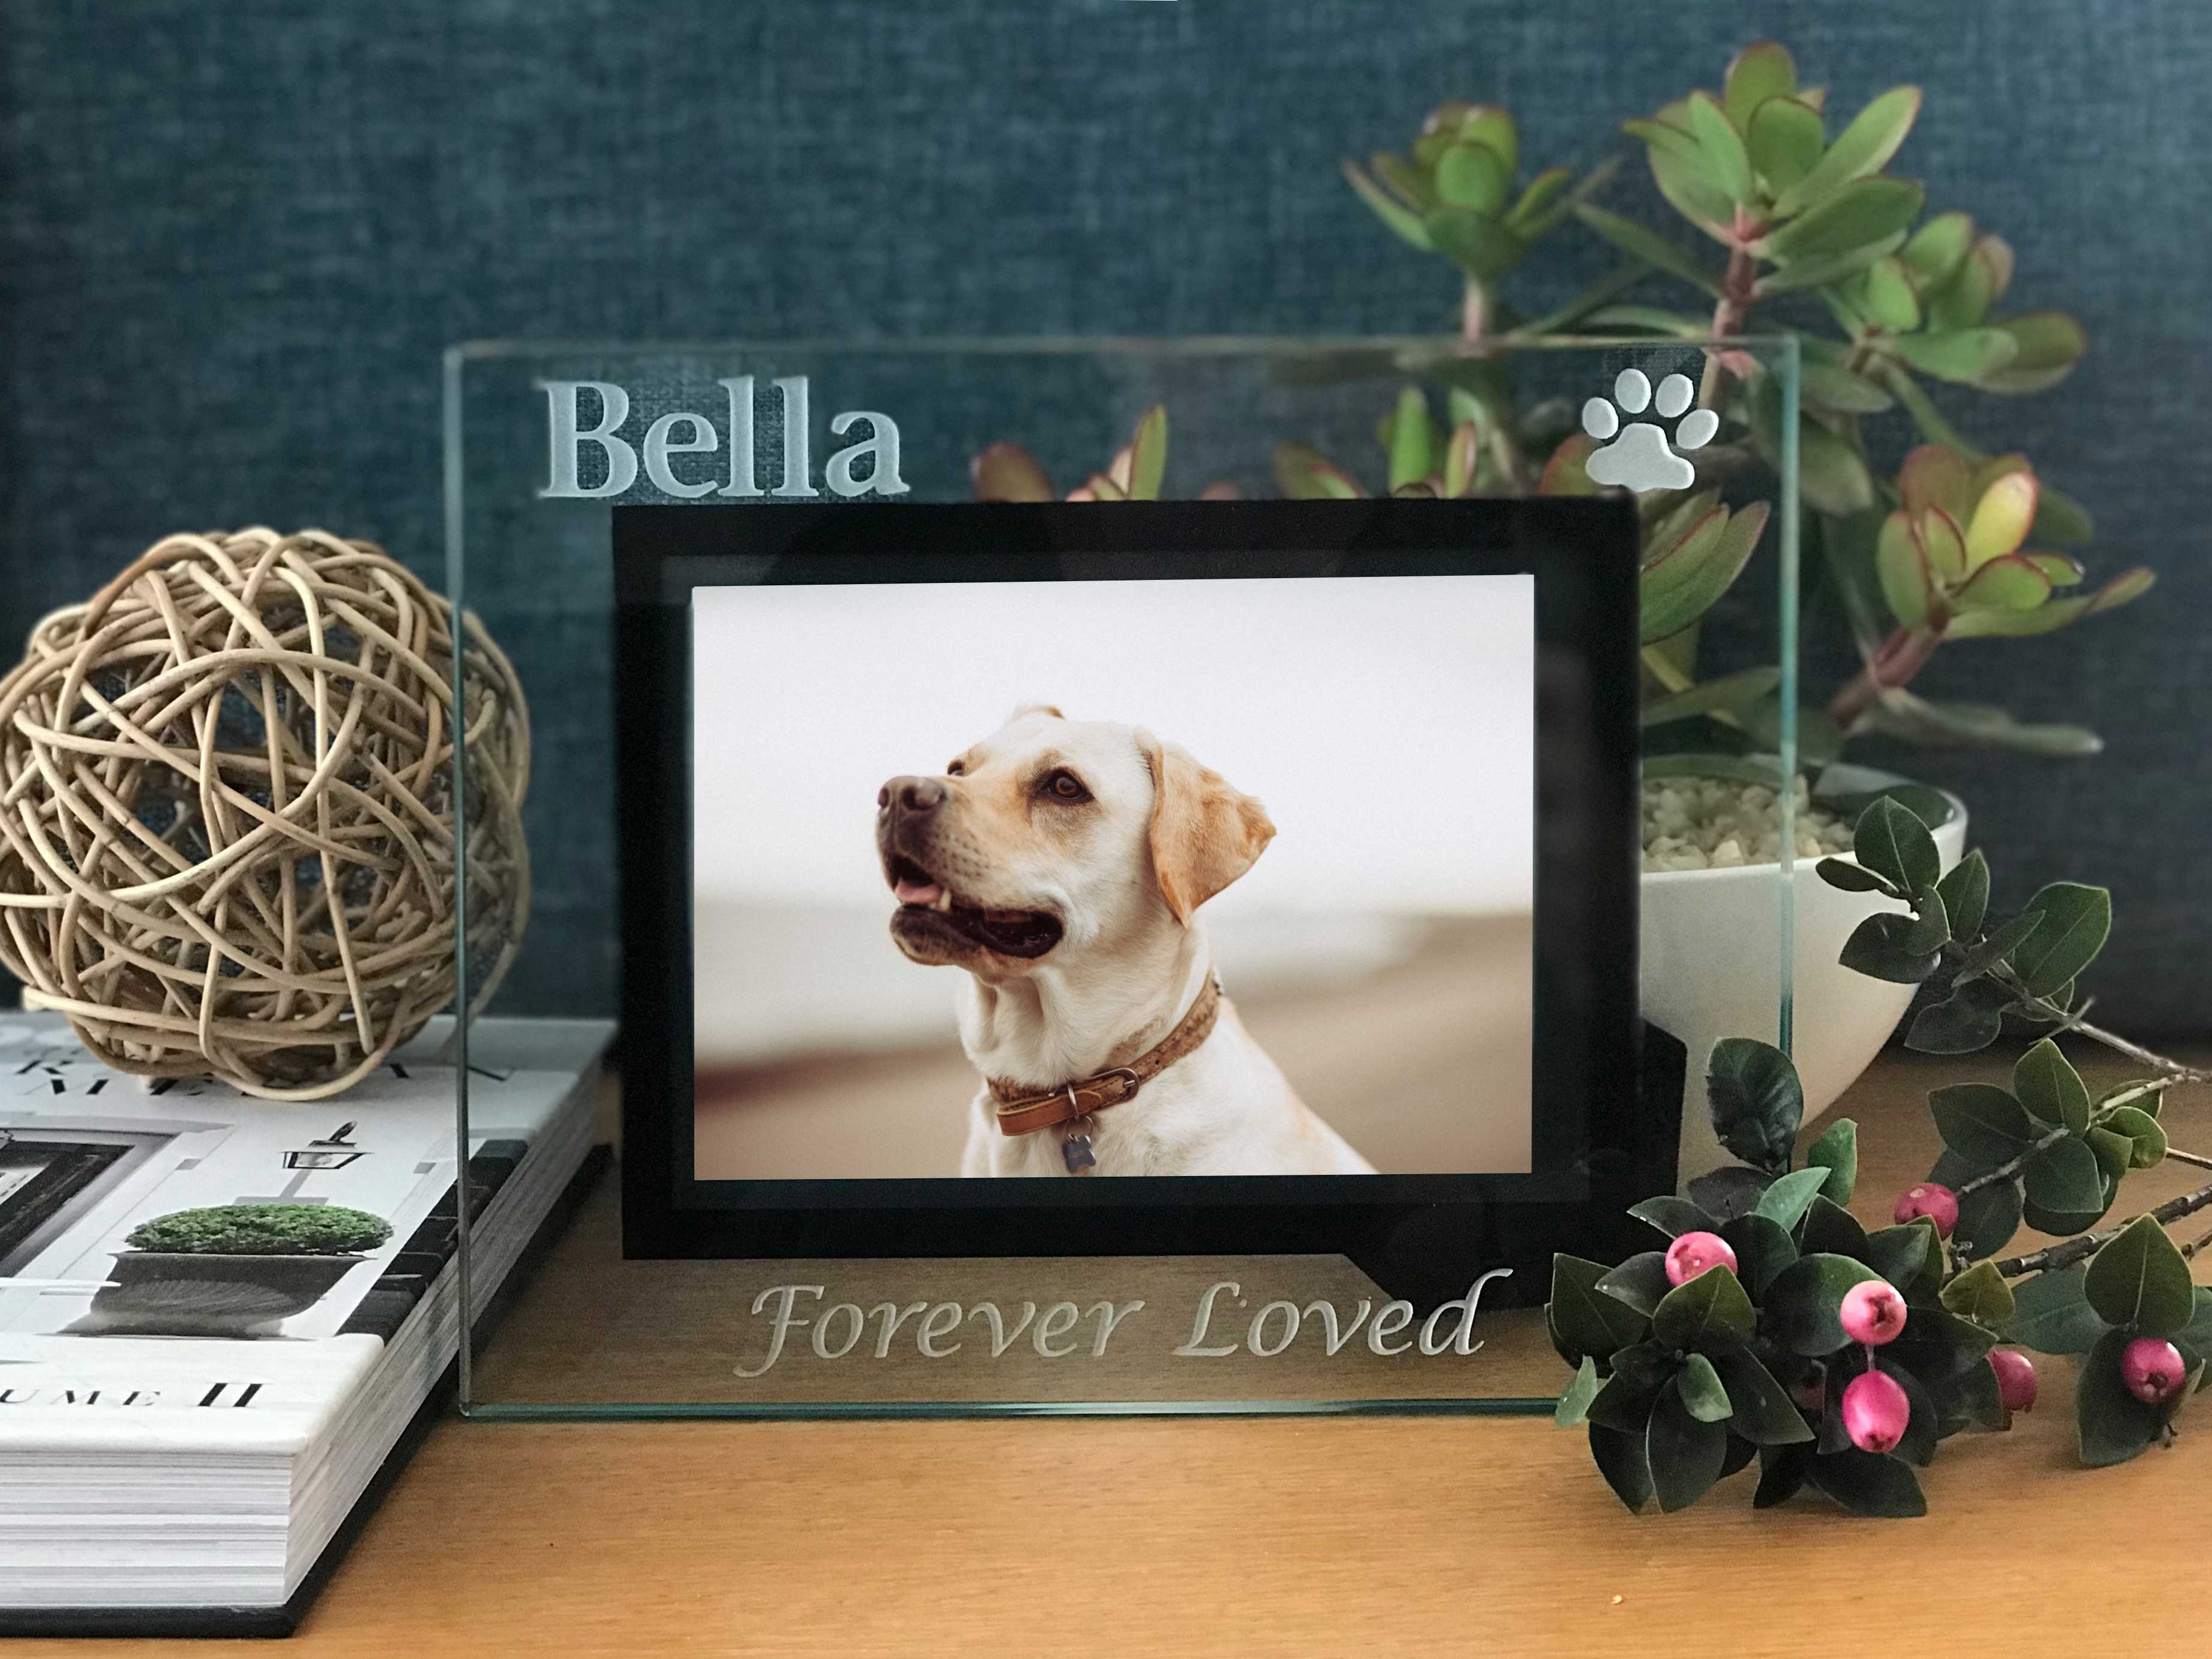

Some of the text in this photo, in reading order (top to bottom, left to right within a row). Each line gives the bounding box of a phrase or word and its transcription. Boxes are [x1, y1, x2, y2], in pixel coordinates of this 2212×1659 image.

[534, 375, 910, 498] Bella
[733, 1269, 1514, 1377] Forever Loved
[193, 1382, 271, 1408] II
